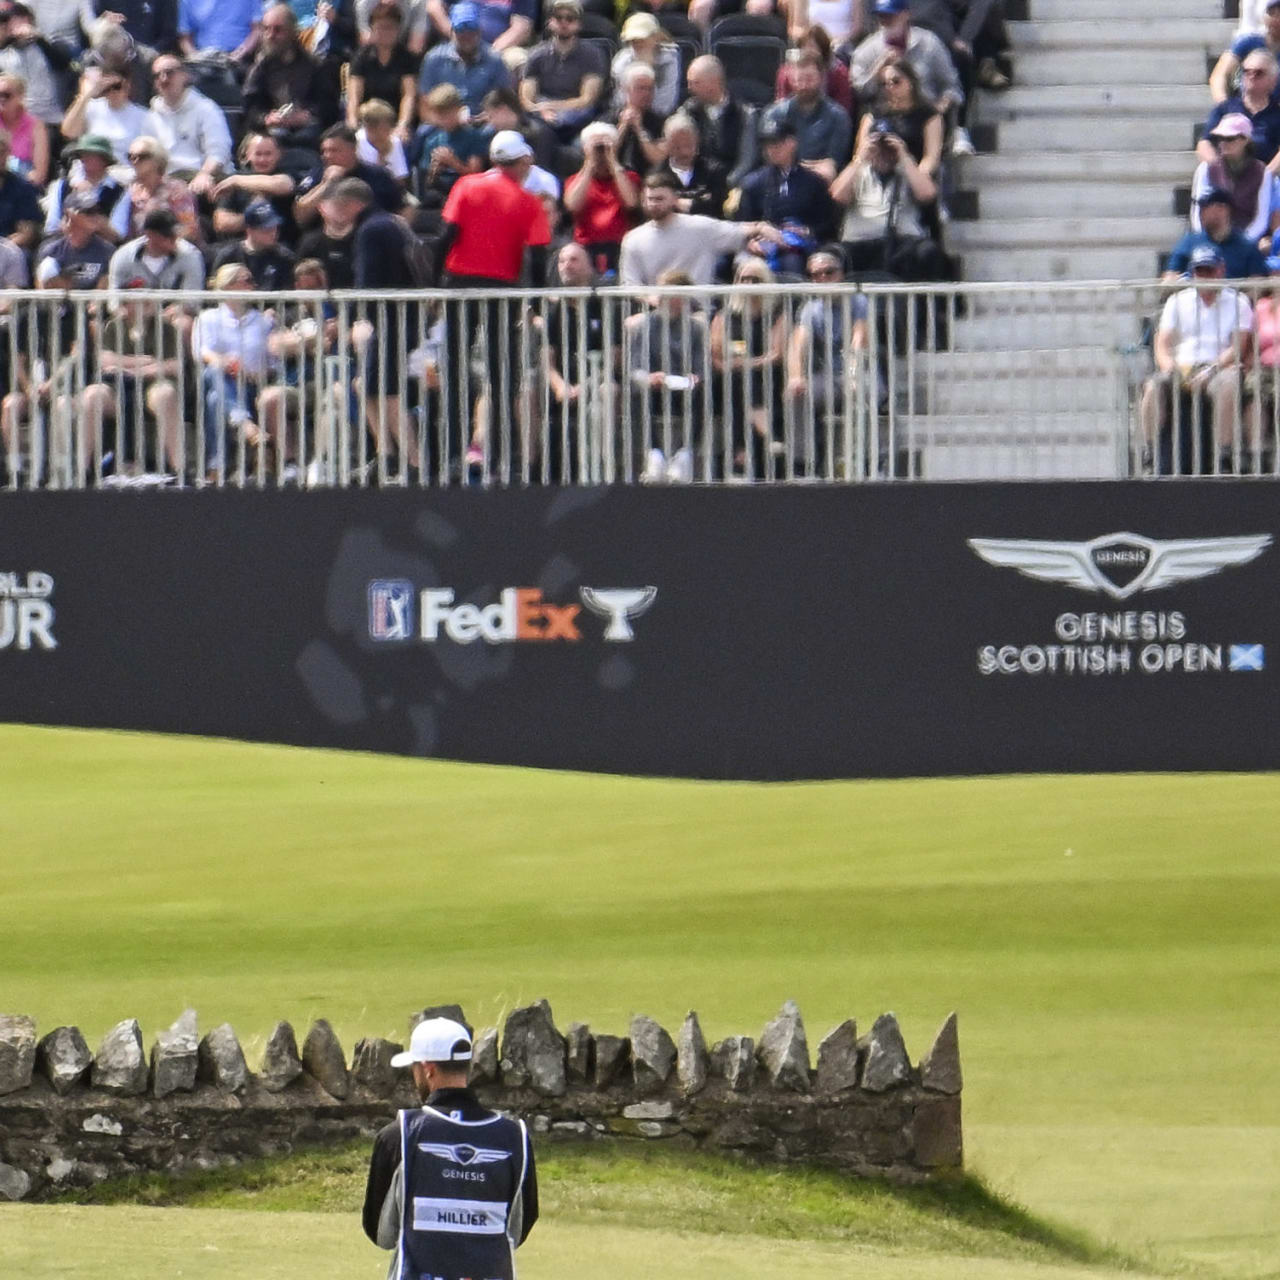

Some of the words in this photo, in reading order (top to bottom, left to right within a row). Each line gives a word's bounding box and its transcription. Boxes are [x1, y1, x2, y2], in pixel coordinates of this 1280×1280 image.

[420, 586, 582, 642] FedEx
[1055, 611, 1186, 640] GENESIS
[977, 644, 1131, 674] SCOTTISH
[1140, 643, 1221, 672] OPEN
[442, 1169, 485, 1181] GENESIS
[437, 1212, 487, 1226] HILLIER
